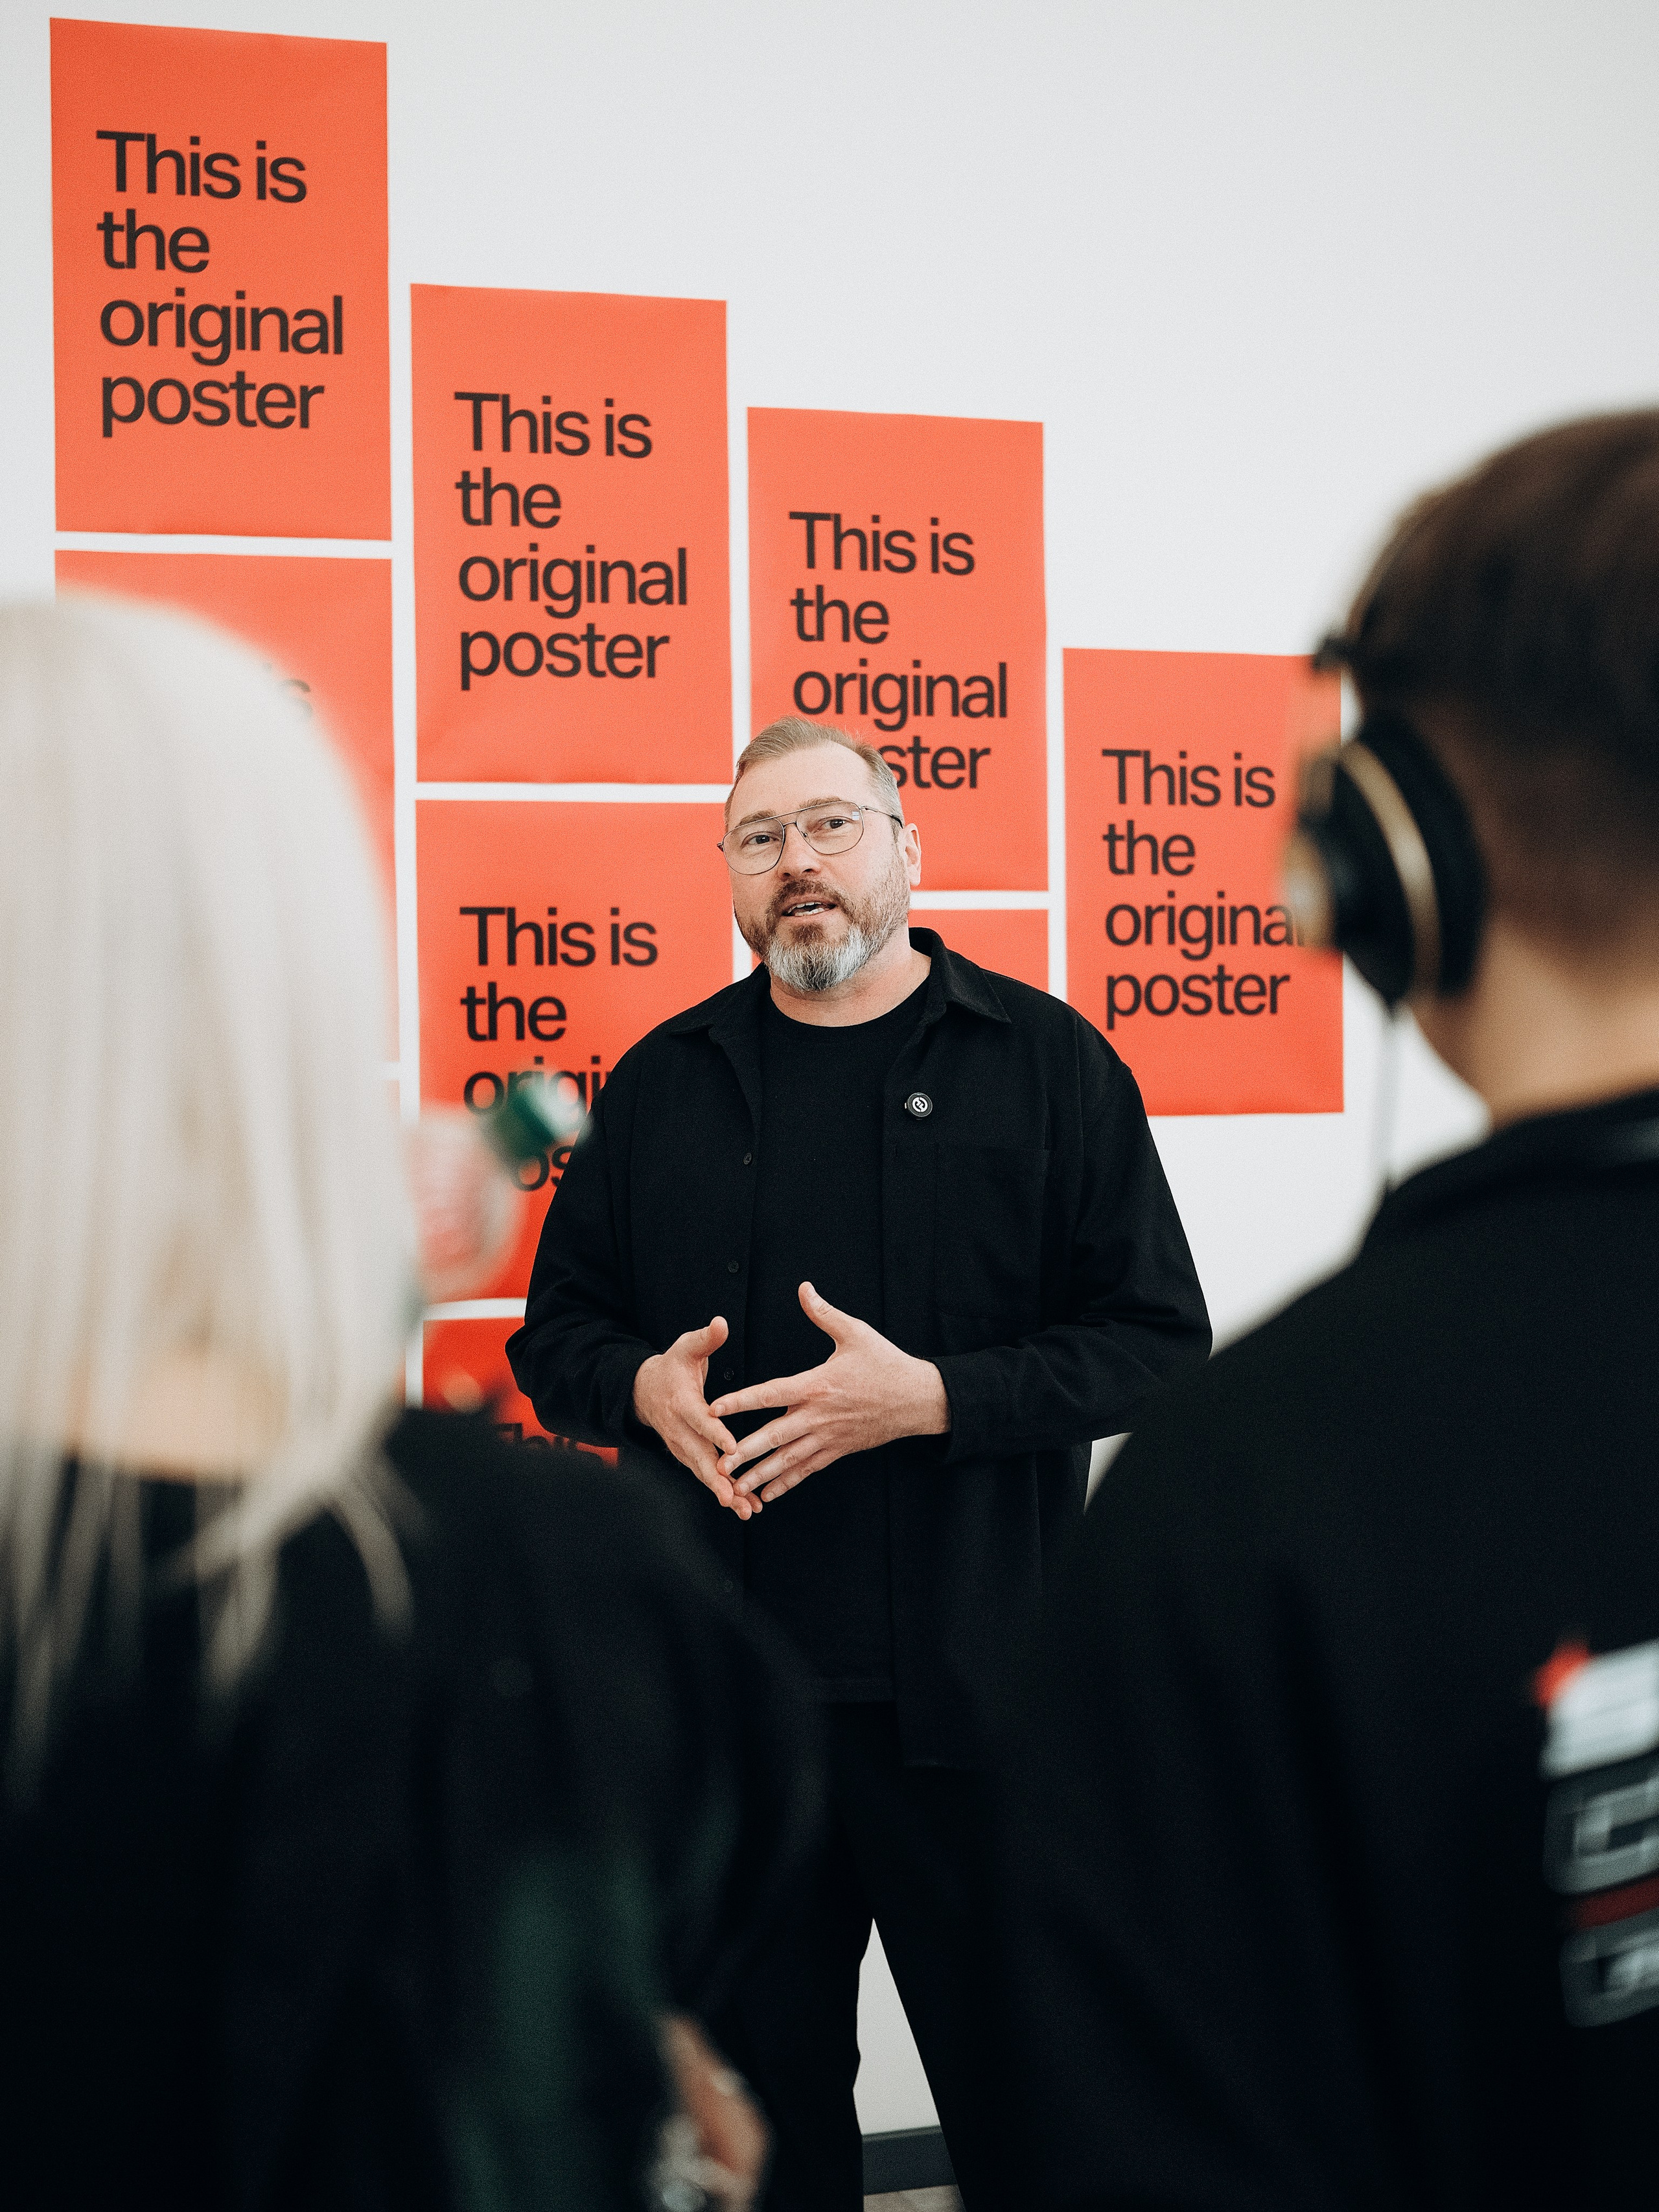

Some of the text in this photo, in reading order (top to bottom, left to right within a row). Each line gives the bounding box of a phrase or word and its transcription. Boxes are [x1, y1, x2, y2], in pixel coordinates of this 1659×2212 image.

[97, 131, 306, 202] This is
[97, 209, 209, 273] the
[101, 288, 342, 366] original
[102, 371, 324, 437] poster
[455, 392, 651, 458] This is
[456, 467, 561, 528] the
[789, 512, 974, 575] This is
[459, 543, 687, 619] original
[790, 585, 888, 644] the
[461, 623, 669, 691] poster
[793, 658, 1007, 732] original
[879, 736, 990, 789] ster
[1102, 750, 1275, 807] This is
[1102, 820, 1195, 876] the
[460, 907, 658, 966] This is
[1106, 891, 1304, 961] origina
[460, 982, 567, 1042] the
[1107, 965, 1290, 1030] poster
